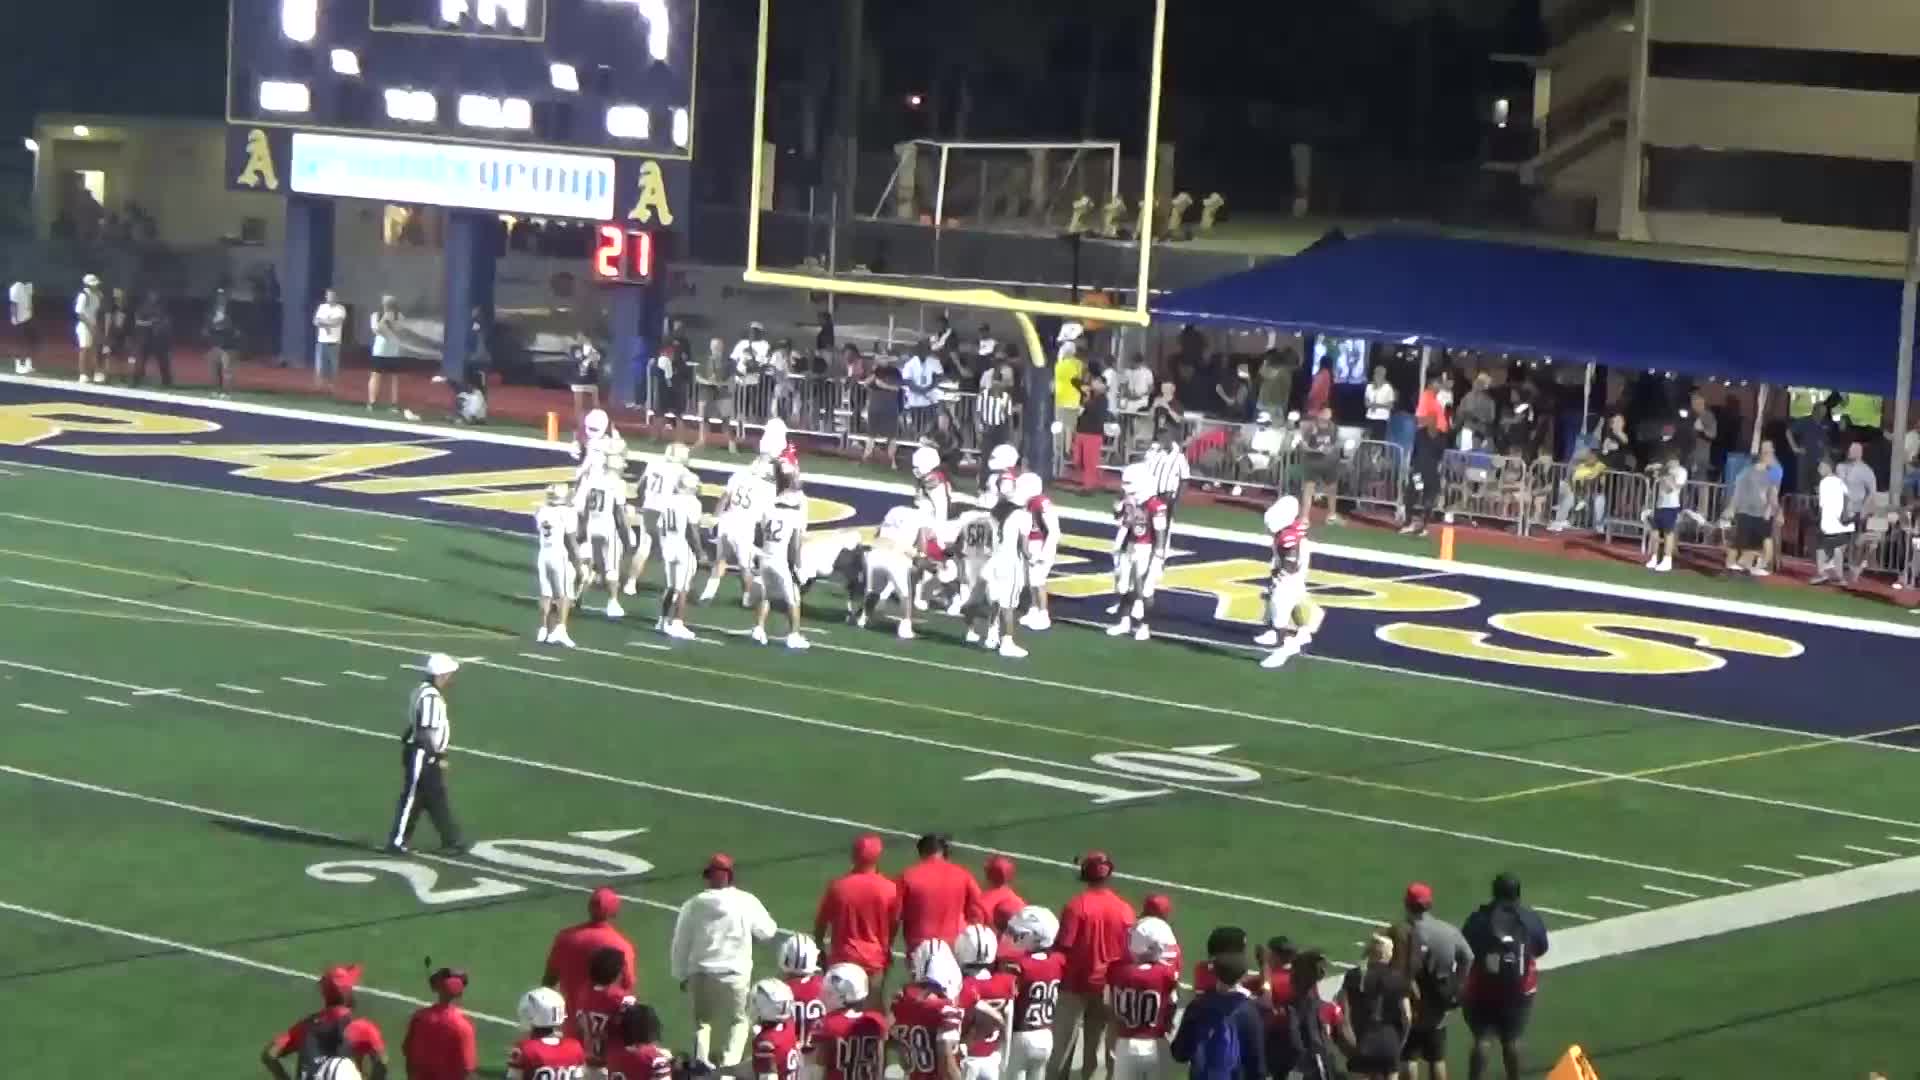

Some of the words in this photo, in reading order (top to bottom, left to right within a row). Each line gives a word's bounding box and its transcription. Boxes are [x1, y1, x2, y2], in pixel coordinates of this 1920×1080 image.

[237, 129, 279, 190] A
[479, 160, 607, 201] group
[628, 160, 673, 225] A
[597, 226, 651, 276] 27
[962, 752, 1262, 804] 10
[305, 839, 655, 905] 20
